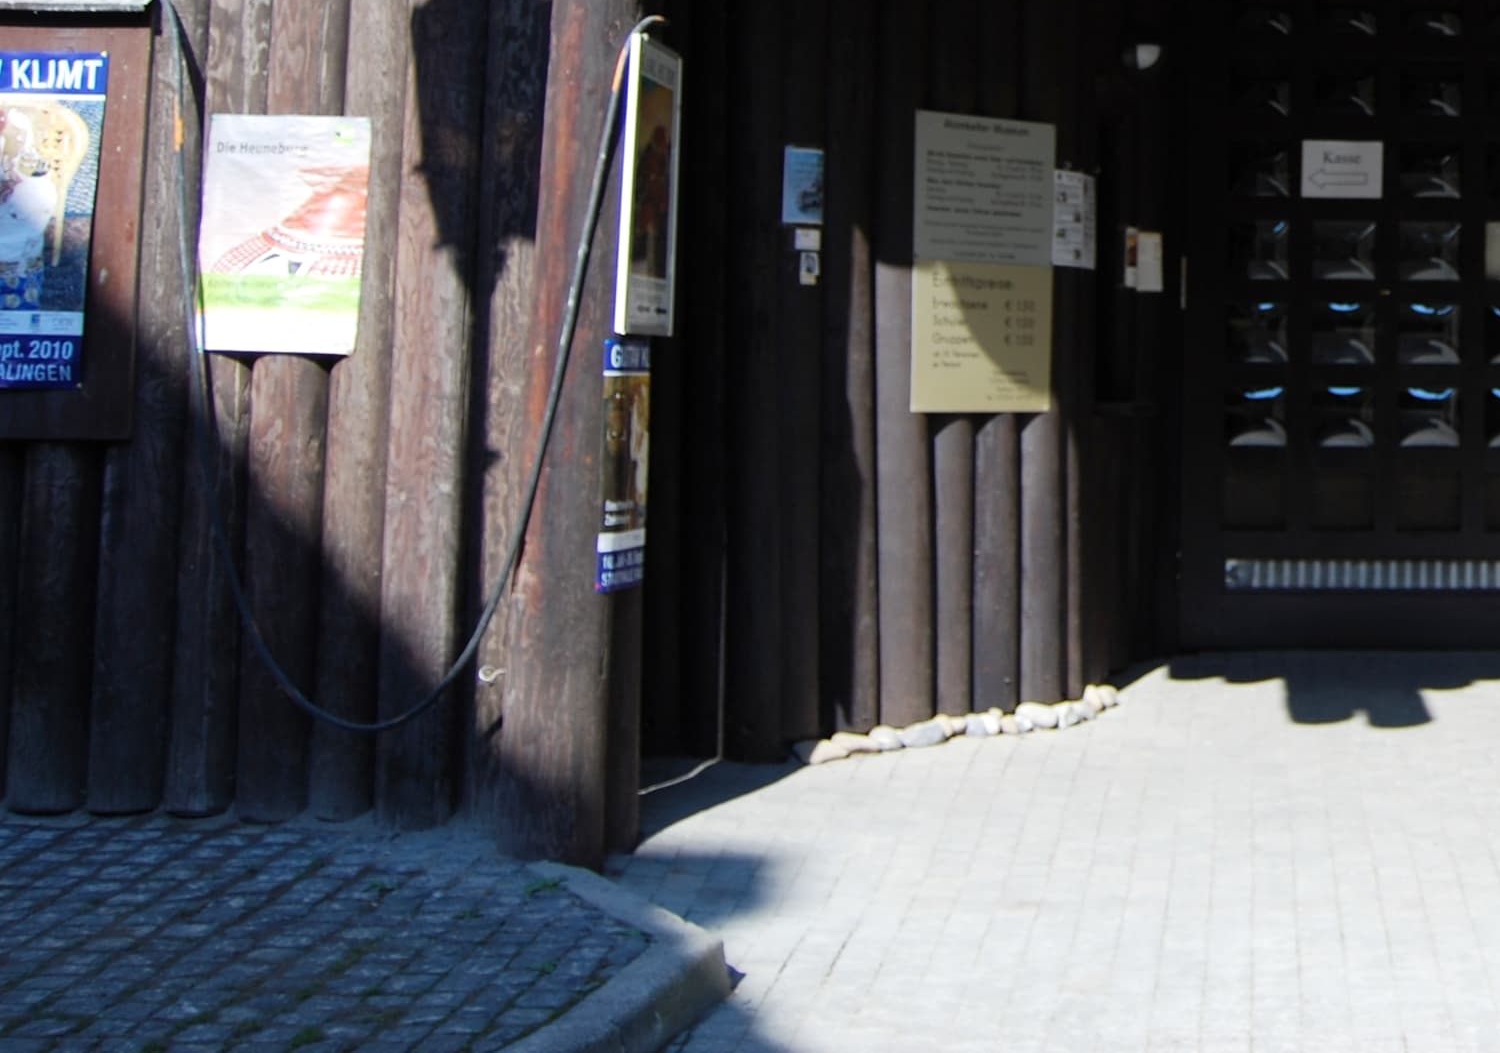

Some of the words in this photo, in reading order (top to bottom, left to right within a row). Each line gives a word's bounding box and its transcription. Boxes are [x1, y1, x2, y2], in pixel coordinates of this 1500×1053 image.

[11, 58, 104, 90] KLIMT
[216, 141, 237, 154] Die
[1323, 150, 1362, 164] Kasse
[0, 339, 24, 362] pt.
[28, 339, 74, 360] 2010
